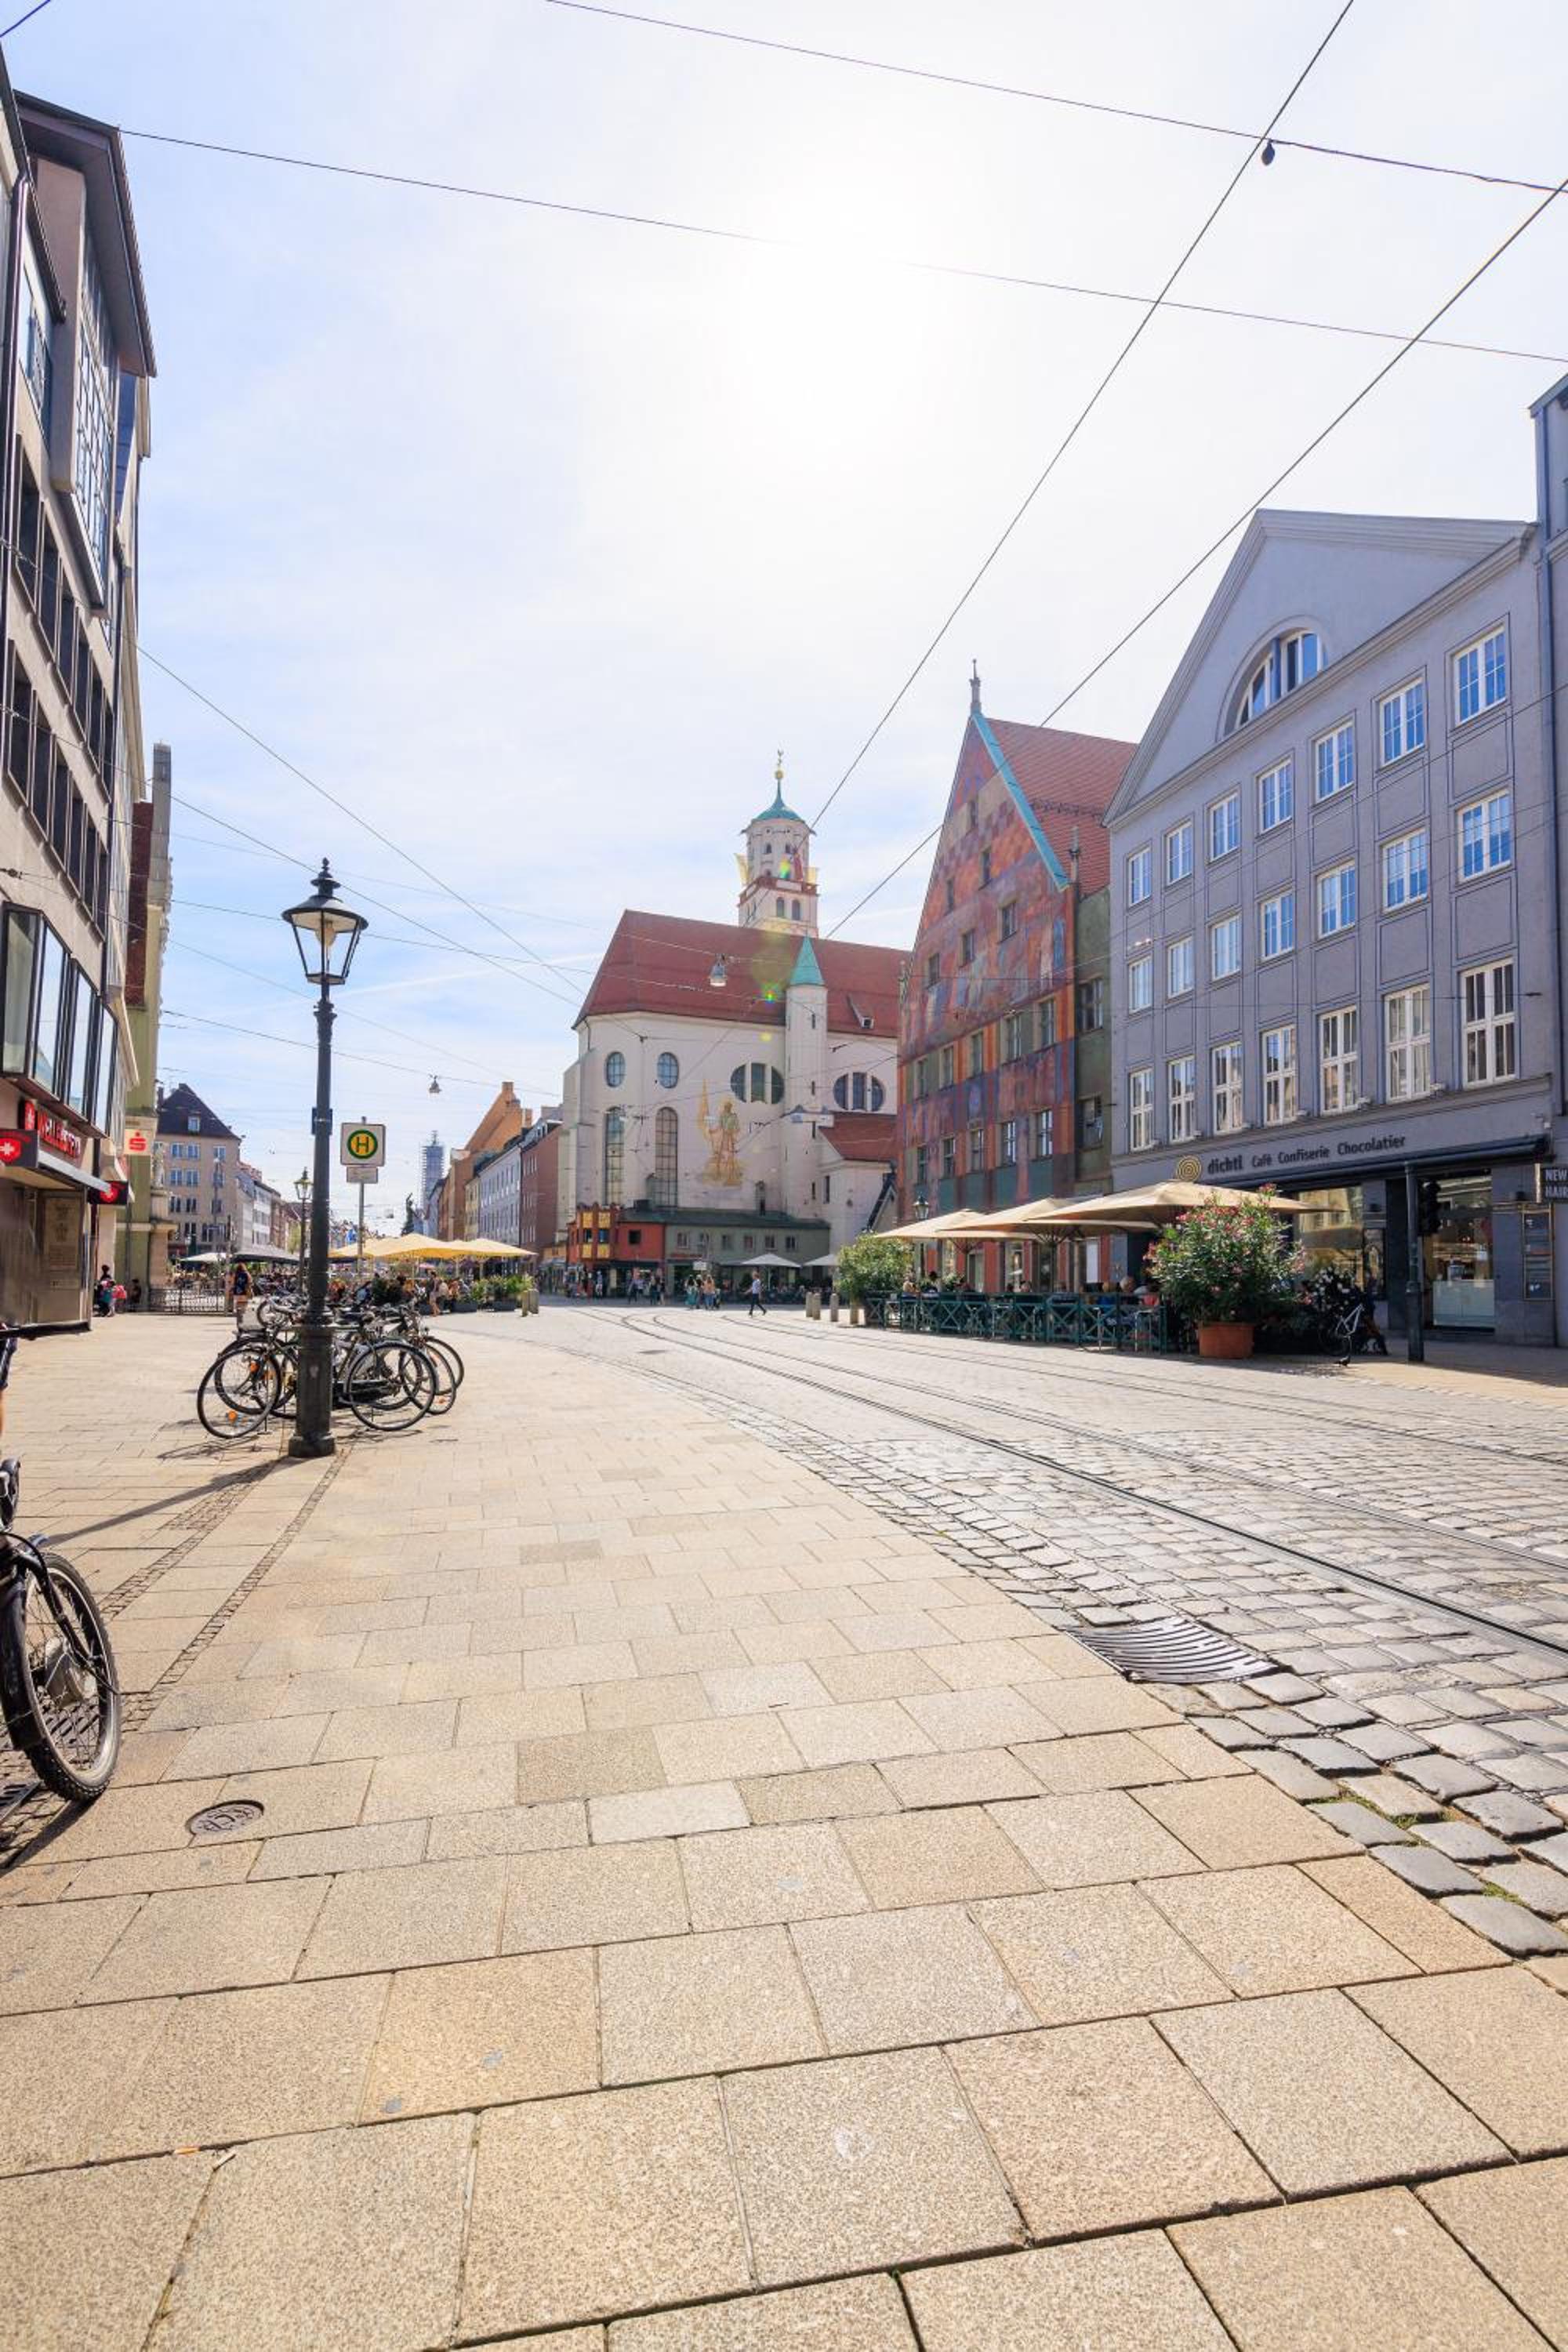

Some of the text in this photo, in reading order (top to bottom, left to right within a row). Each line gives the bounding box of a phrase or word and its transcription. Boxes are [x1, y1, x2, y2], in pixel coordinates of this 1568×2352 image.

[356, 1135, 369, 1152] H
[1207, 1154, 1243, 1174] dichtl
[1277, 1145, 1330, 1164] Confiserie
[1337, 1134, 1406, 1155] Chocolatier
[1545, 1169, 1567, 1181] NEW
